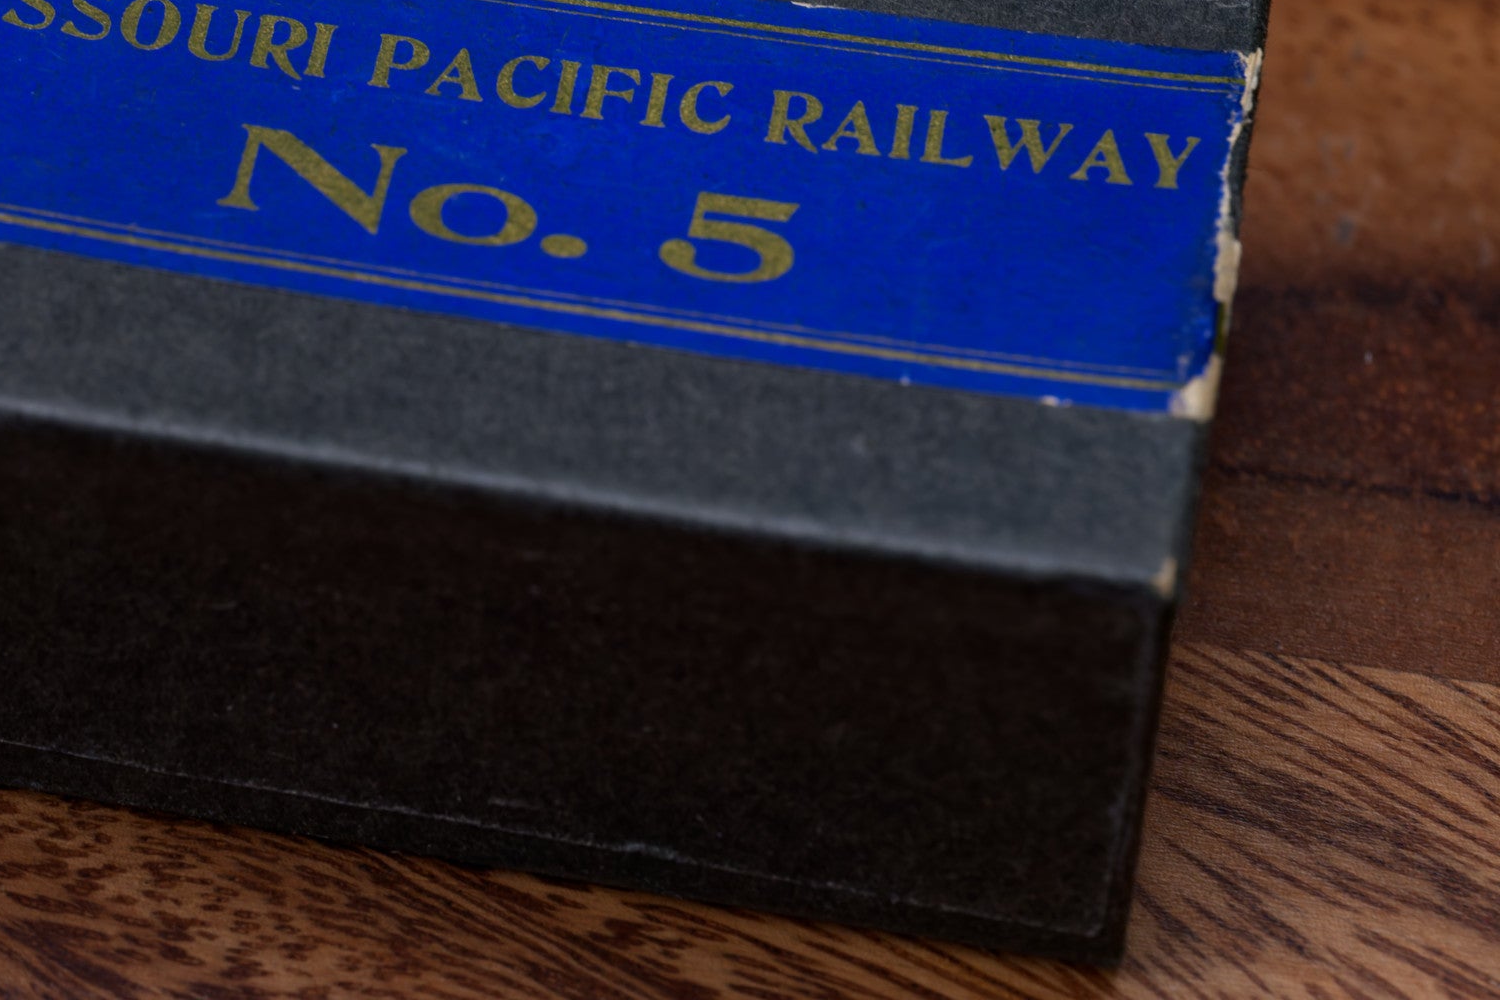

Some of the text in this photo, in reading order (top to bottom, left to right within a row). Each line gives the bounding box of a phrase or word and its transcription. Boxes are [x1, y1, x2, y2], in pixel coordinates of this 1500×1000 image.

[366, 32, 736, 136] PACIFIC
[763, 88, 1202, 190] RAILWAY
[215, 123, 801, 284] No. 5
